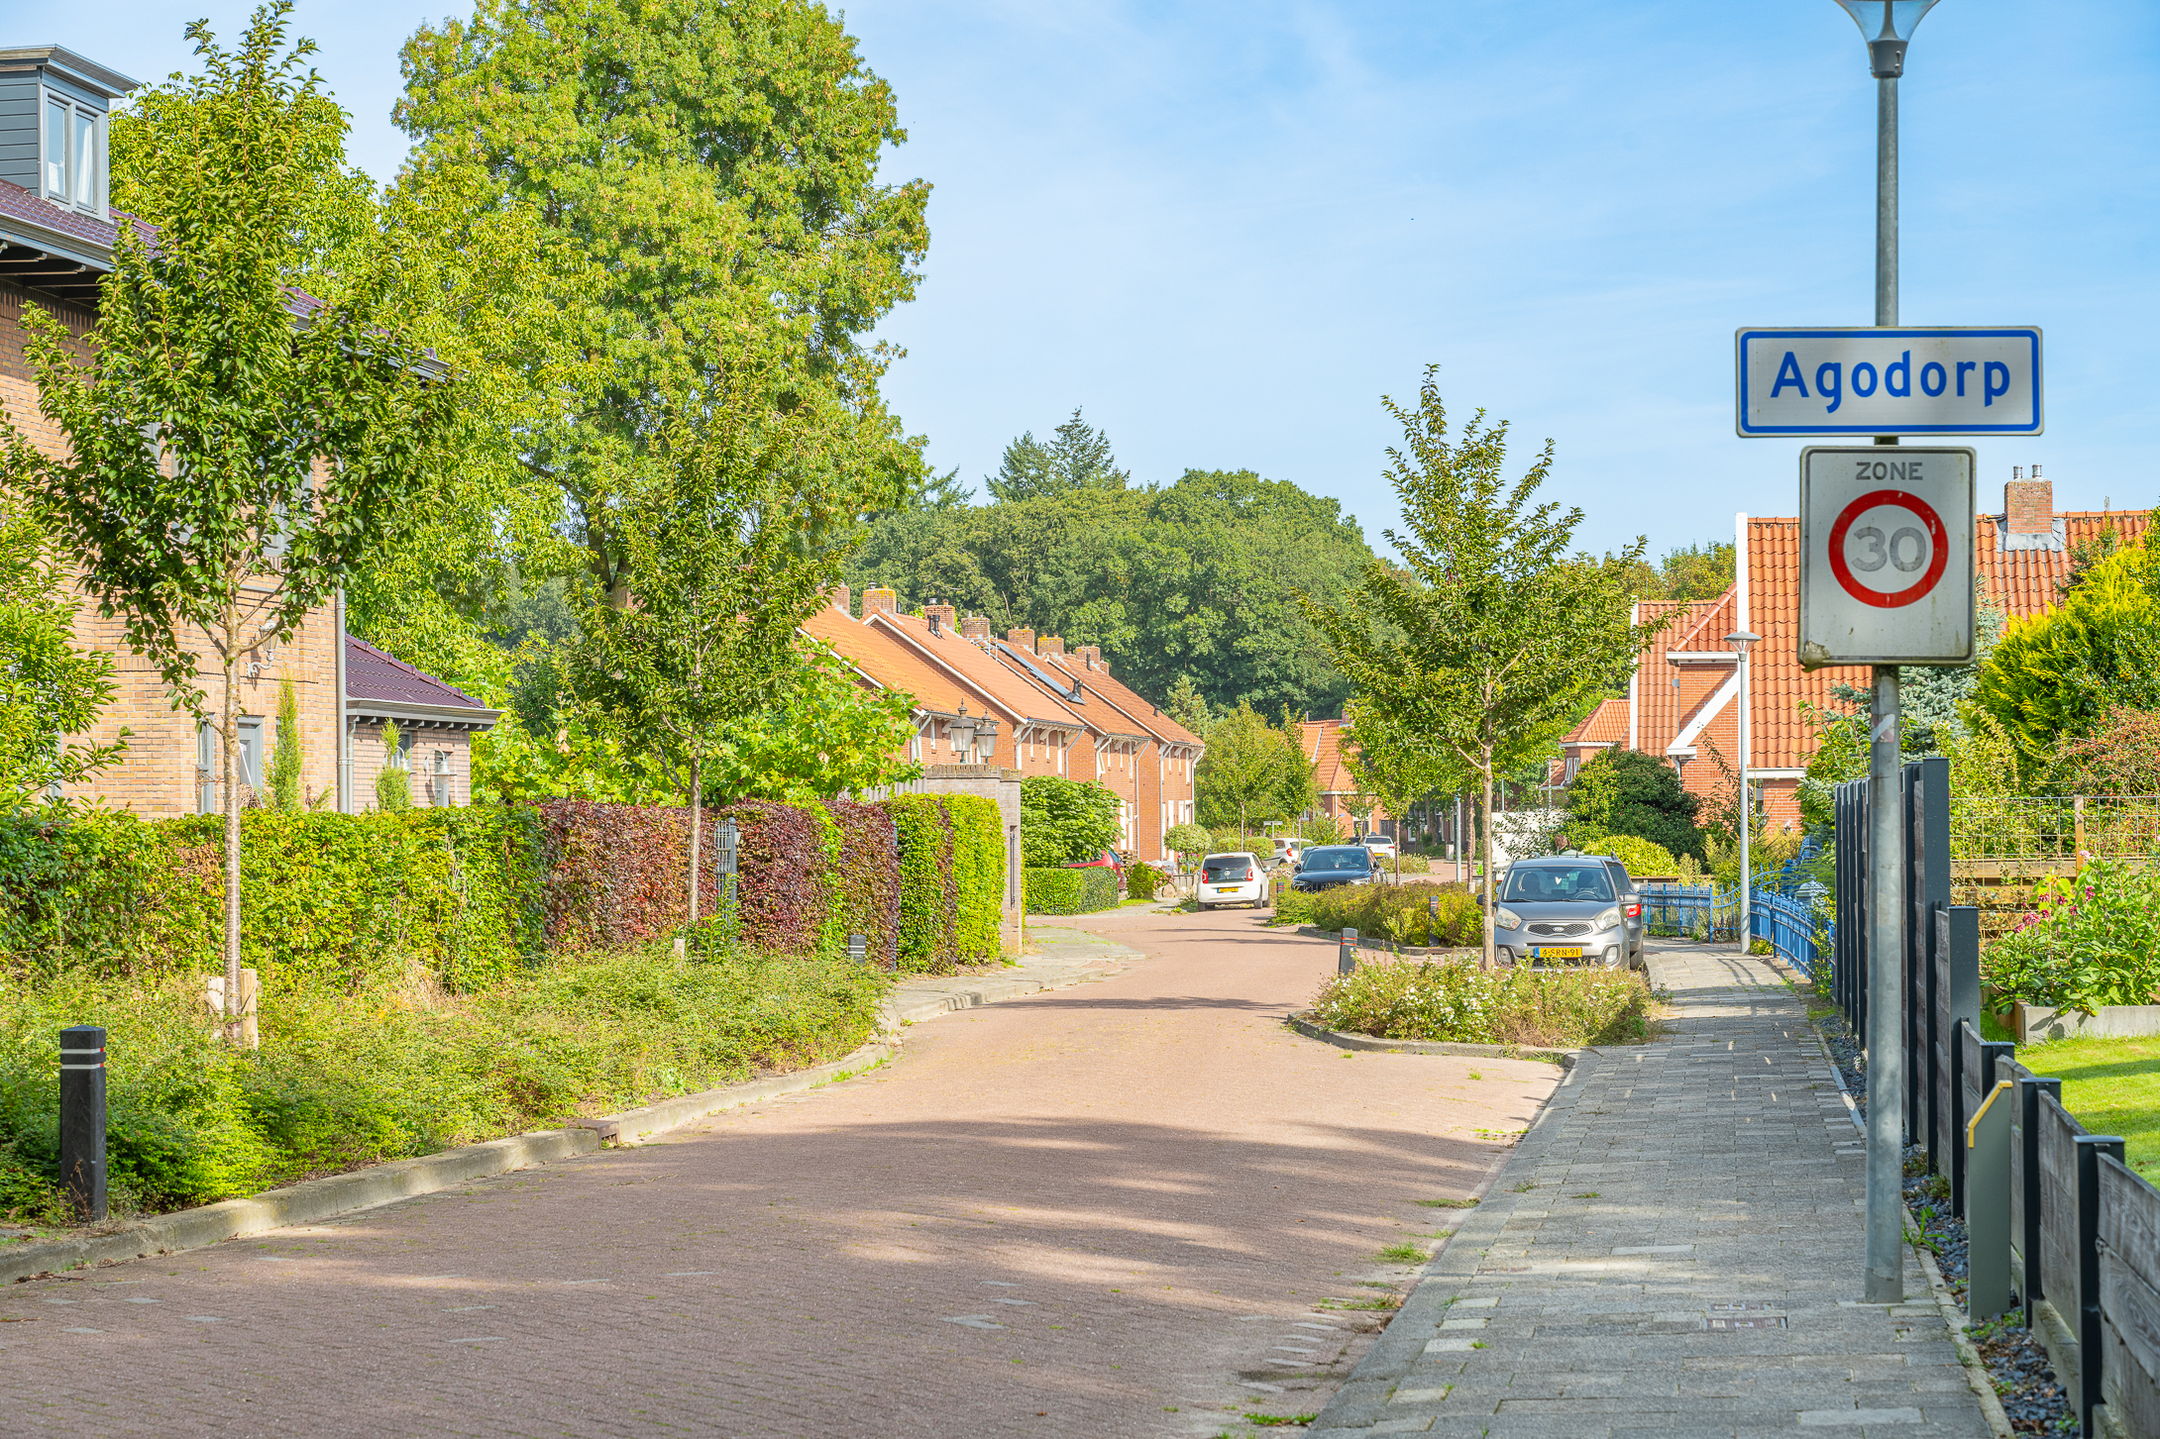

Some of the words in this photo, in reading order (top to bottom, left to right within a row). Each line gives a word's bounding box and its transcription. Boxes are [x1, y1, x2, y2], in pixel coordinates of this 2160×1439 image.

[1770, 350, 2010, 413] Agodorp
[1856, 461, 1923, 480] ZONE
[1851, 526, 1927, 572] 30
